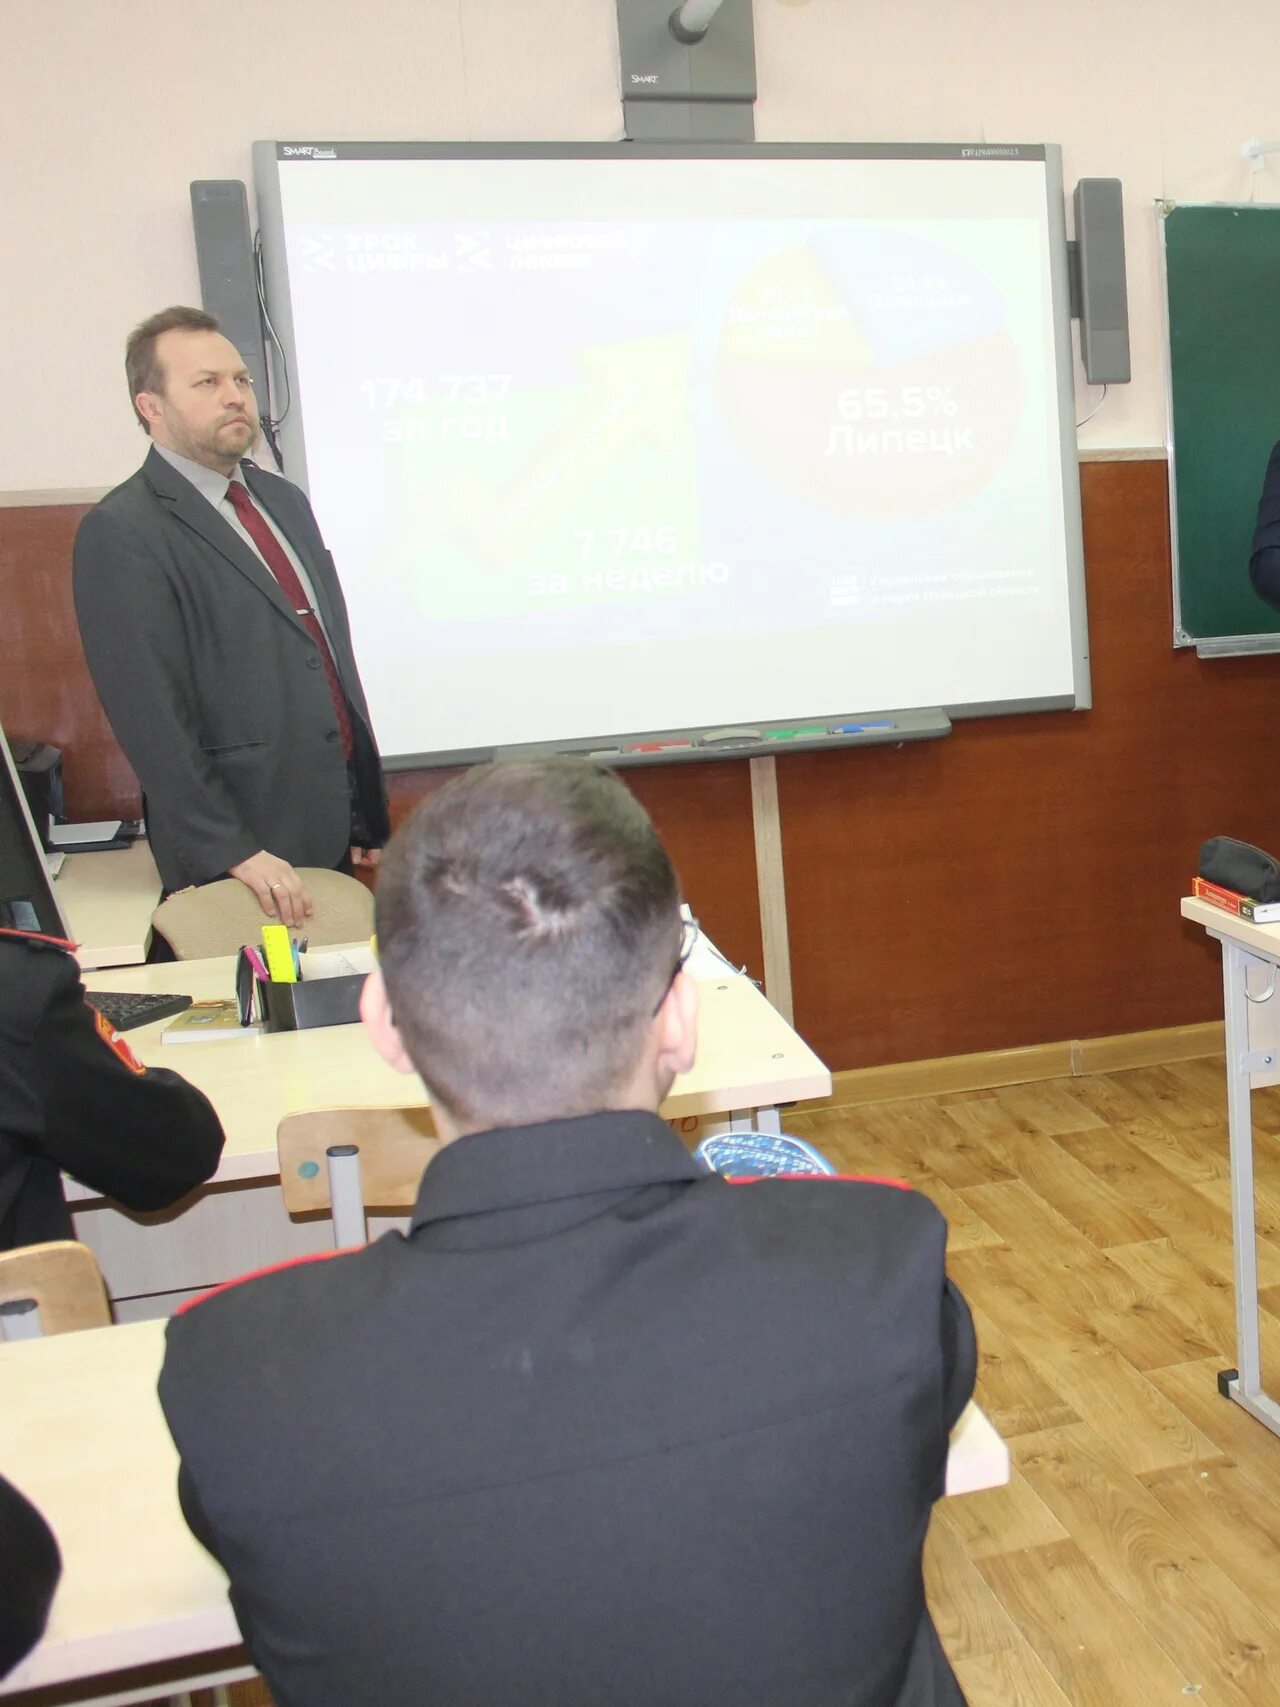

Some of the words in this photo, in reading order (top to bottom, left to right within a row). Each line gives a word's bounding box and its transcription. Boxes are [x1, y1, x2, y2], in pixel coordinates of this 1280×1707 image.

[631, 74, 660, 84] SMART
[283, 146, 314, 156] SMART
[345, 231, 420, 252] УРОК
[346, 251, 449, 276] ЦИФРЫ
[360, 376, 428, 410] 174
[439, 374, 513, 408] 737
[838, 384, 959, 423] 65,5%
[382, 417, 427, 443] за
[441, 412, 513, 448] год
[825, 424, 976, 457] Липецк
[569, 527, 596, 561] 7
[608, 524, 680, 558] 746
[528, 572, 570, 597] за
[581, 562, 729, 594] неделю
